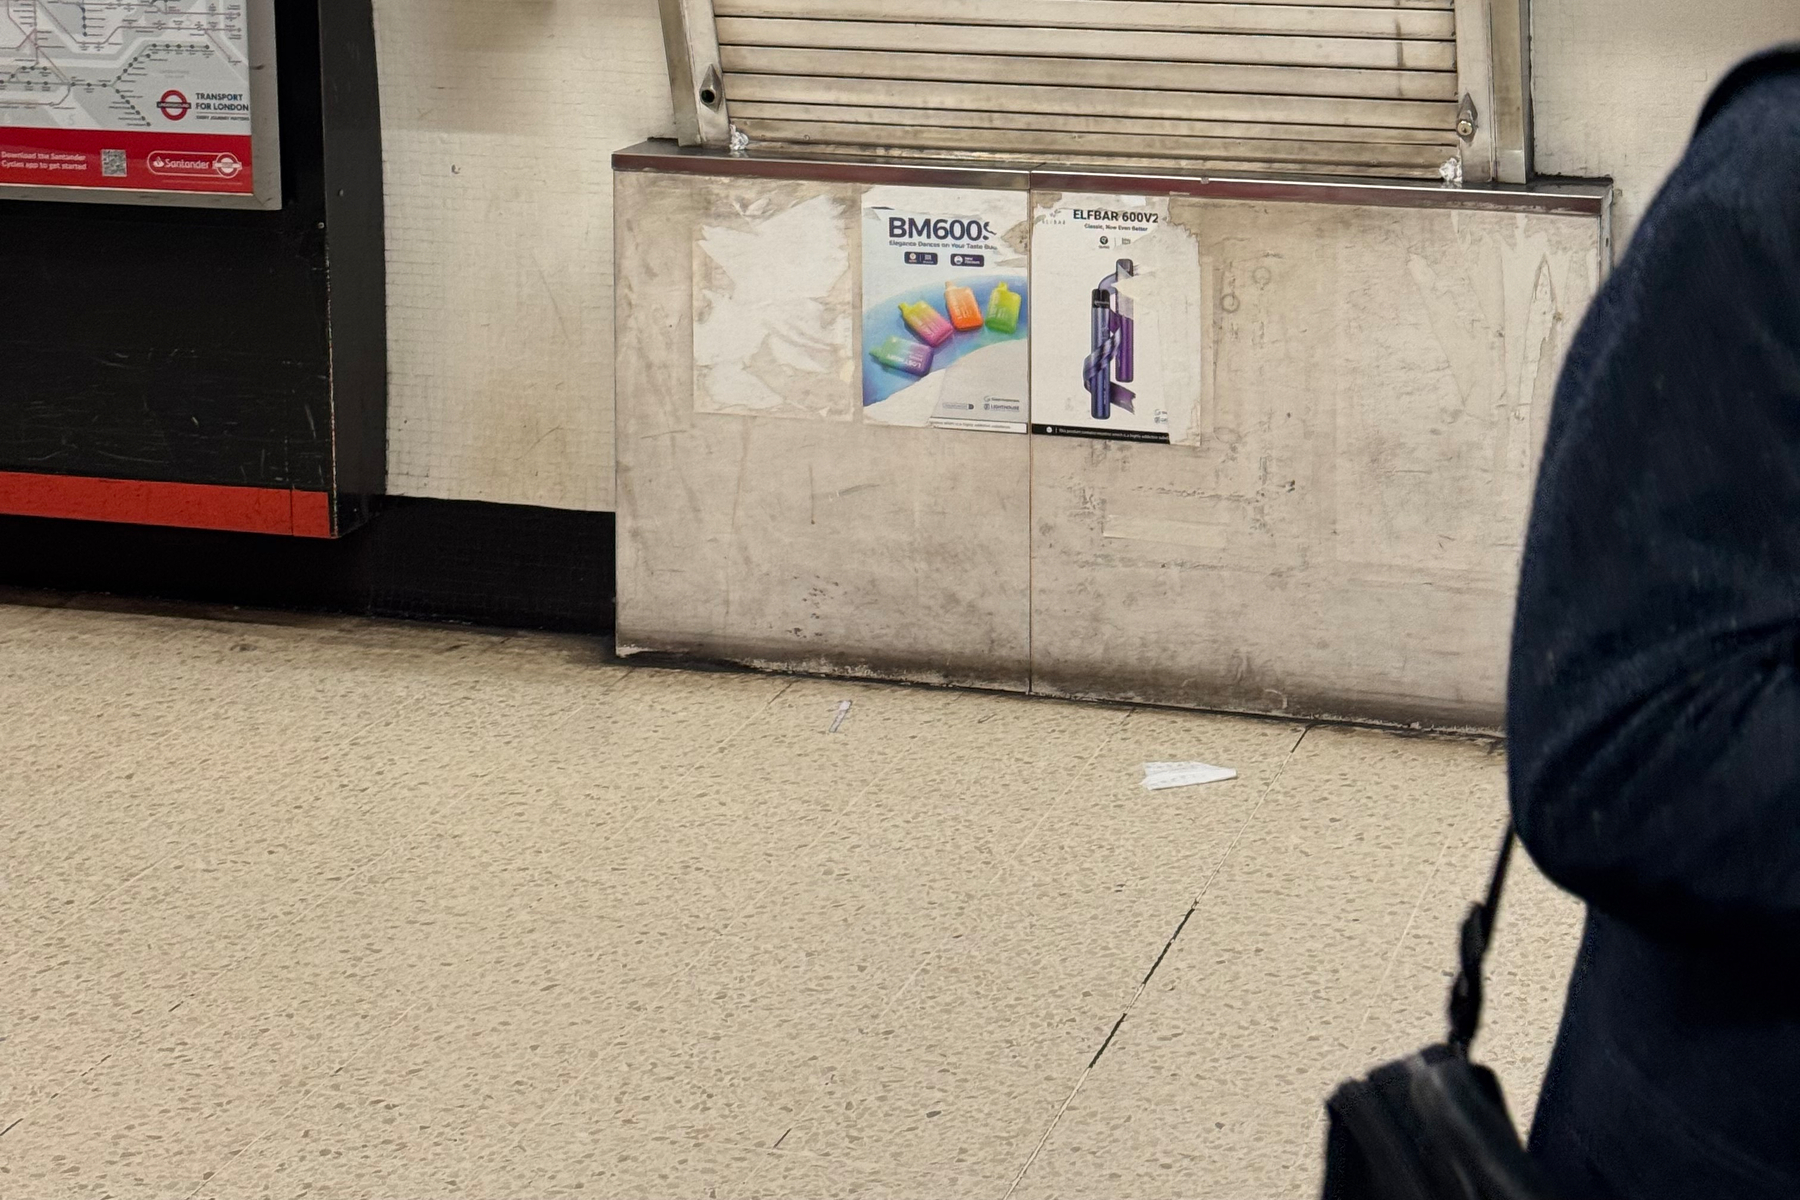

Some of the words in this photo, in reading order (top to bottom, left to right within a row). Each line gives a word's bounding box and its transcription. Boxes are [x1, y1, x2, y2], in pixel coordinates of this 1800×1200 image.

[195, 93, 243, 101] TRANSPORT
[214, 103, 249, 111] LONDON
[1, 151, 36, 159] Download
[51, 152, 86, 160] Santander
[164, 158, 210, 169] Santander
[1073, 208, 1119, 222] ELFBAR
[1121, 210, 1159, 224] 600V2
[888, 239, 917, 247] Elegance
